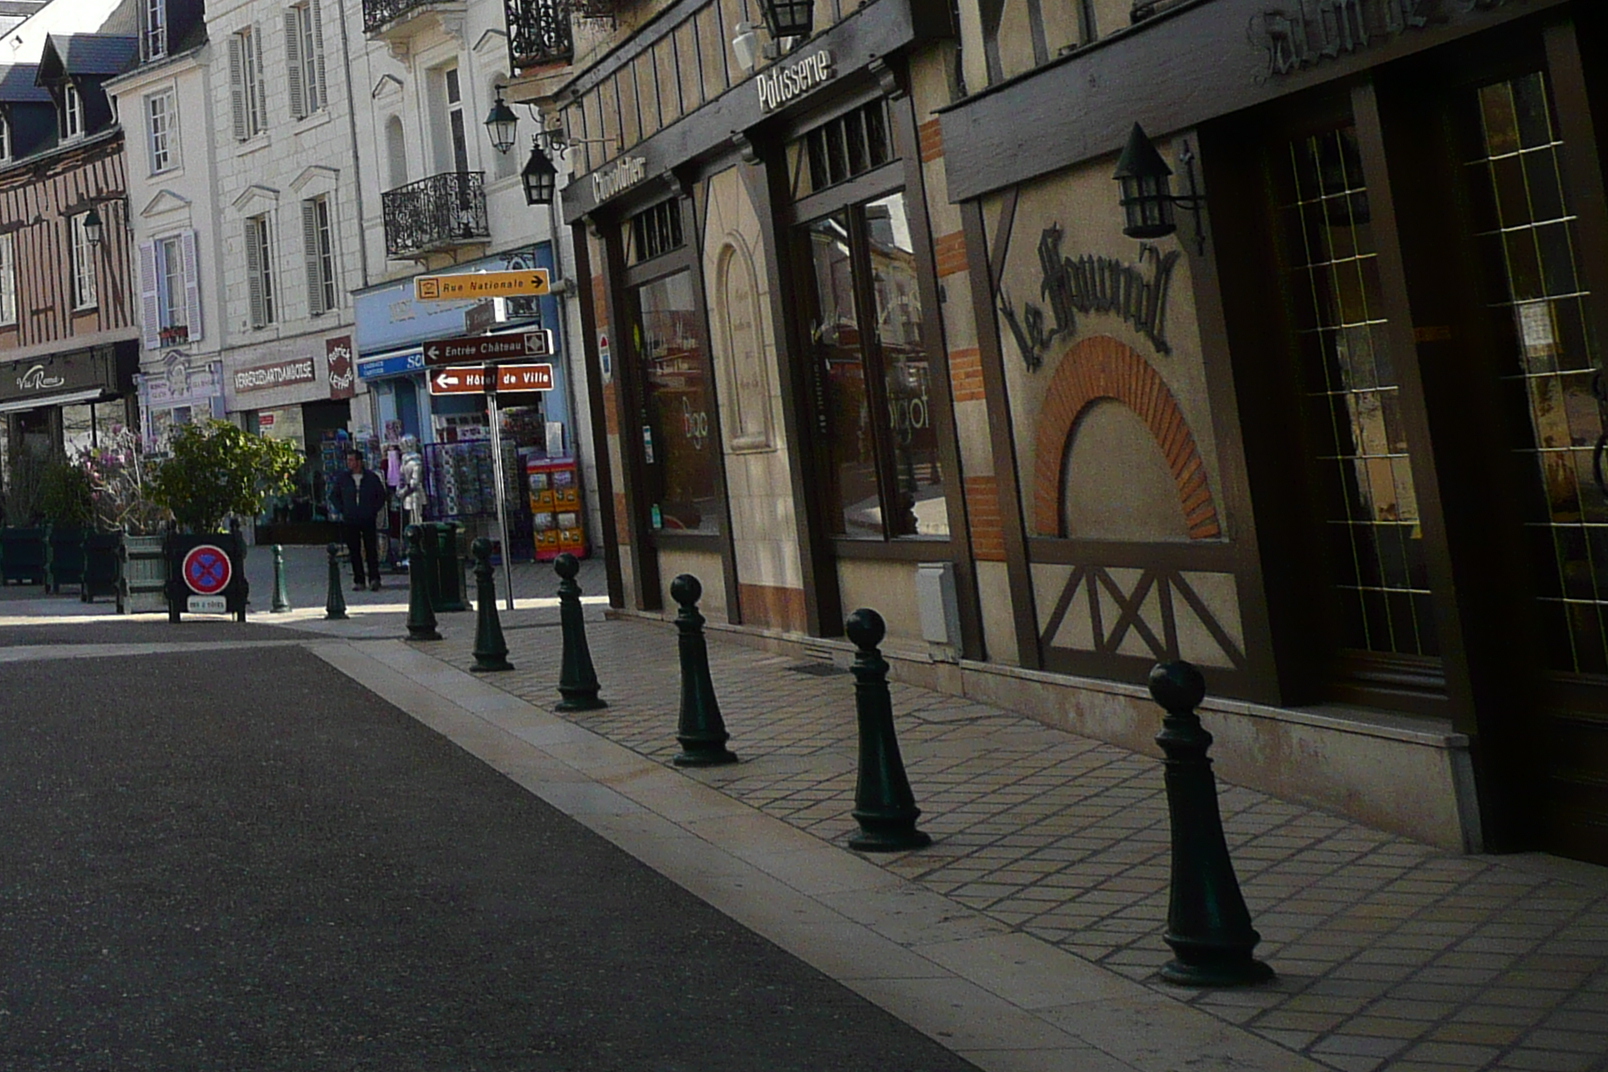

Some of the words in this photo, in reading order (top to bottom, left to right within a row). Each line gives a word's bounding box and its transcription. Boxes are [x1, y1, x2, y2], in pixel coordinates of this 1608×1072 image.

[443, 283, 463, 293] Rue
[470, 279, 524, 291] Nationale
[406, 354, 425, 369] SO
[466, 374, 496, 386] Hôtel
[503, 372, 516, 384] de
[523, 371, 549, 384] Ville
